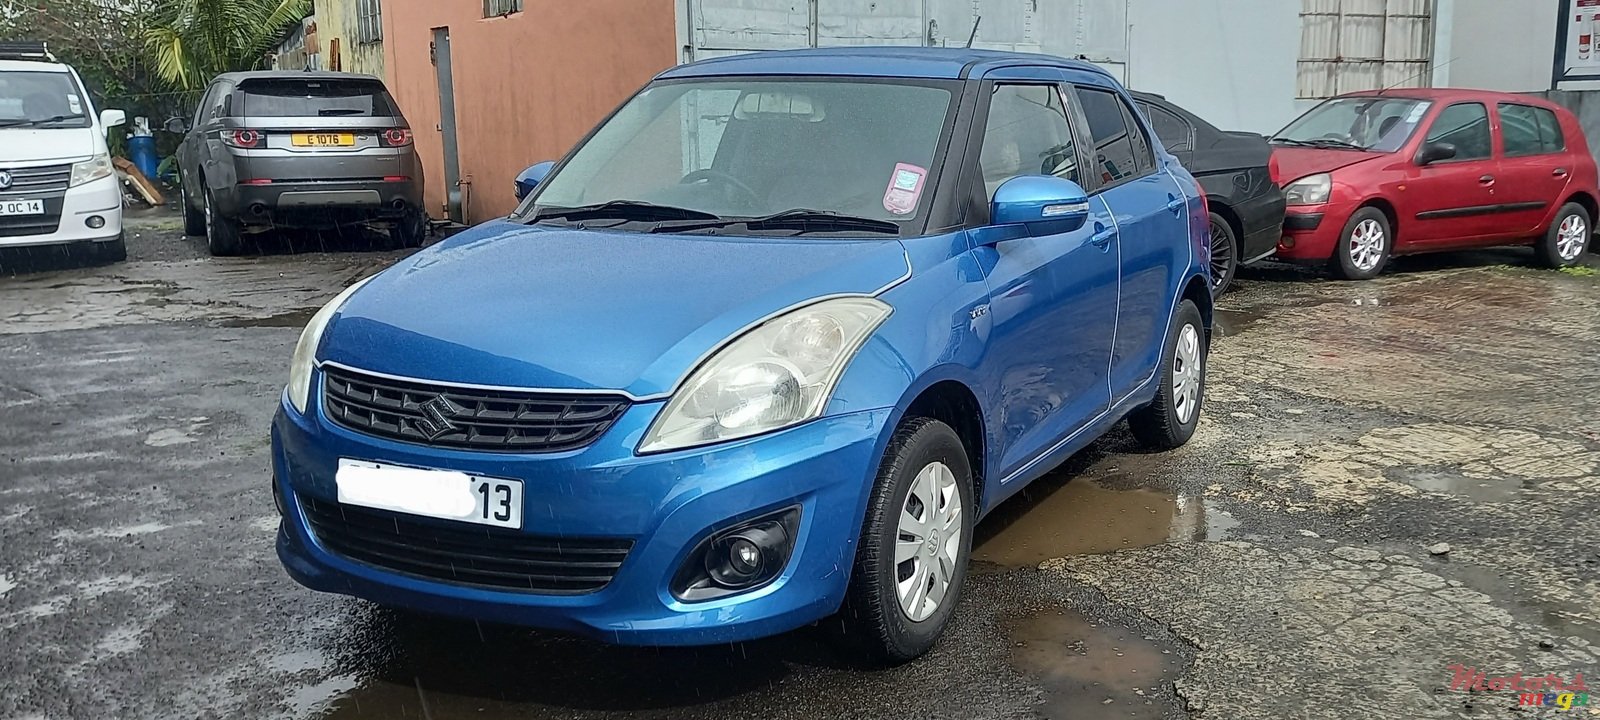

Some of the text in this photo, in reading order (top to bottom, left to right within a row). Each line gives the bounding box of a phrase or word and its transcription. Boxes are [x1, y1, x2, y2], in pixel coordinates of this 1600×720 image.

[307, 134, 339, 144] E 1076
[8, 203, 23, 213] OC
[27, 202, 39, 212] 14
[478, 482, 512, 522] 13
